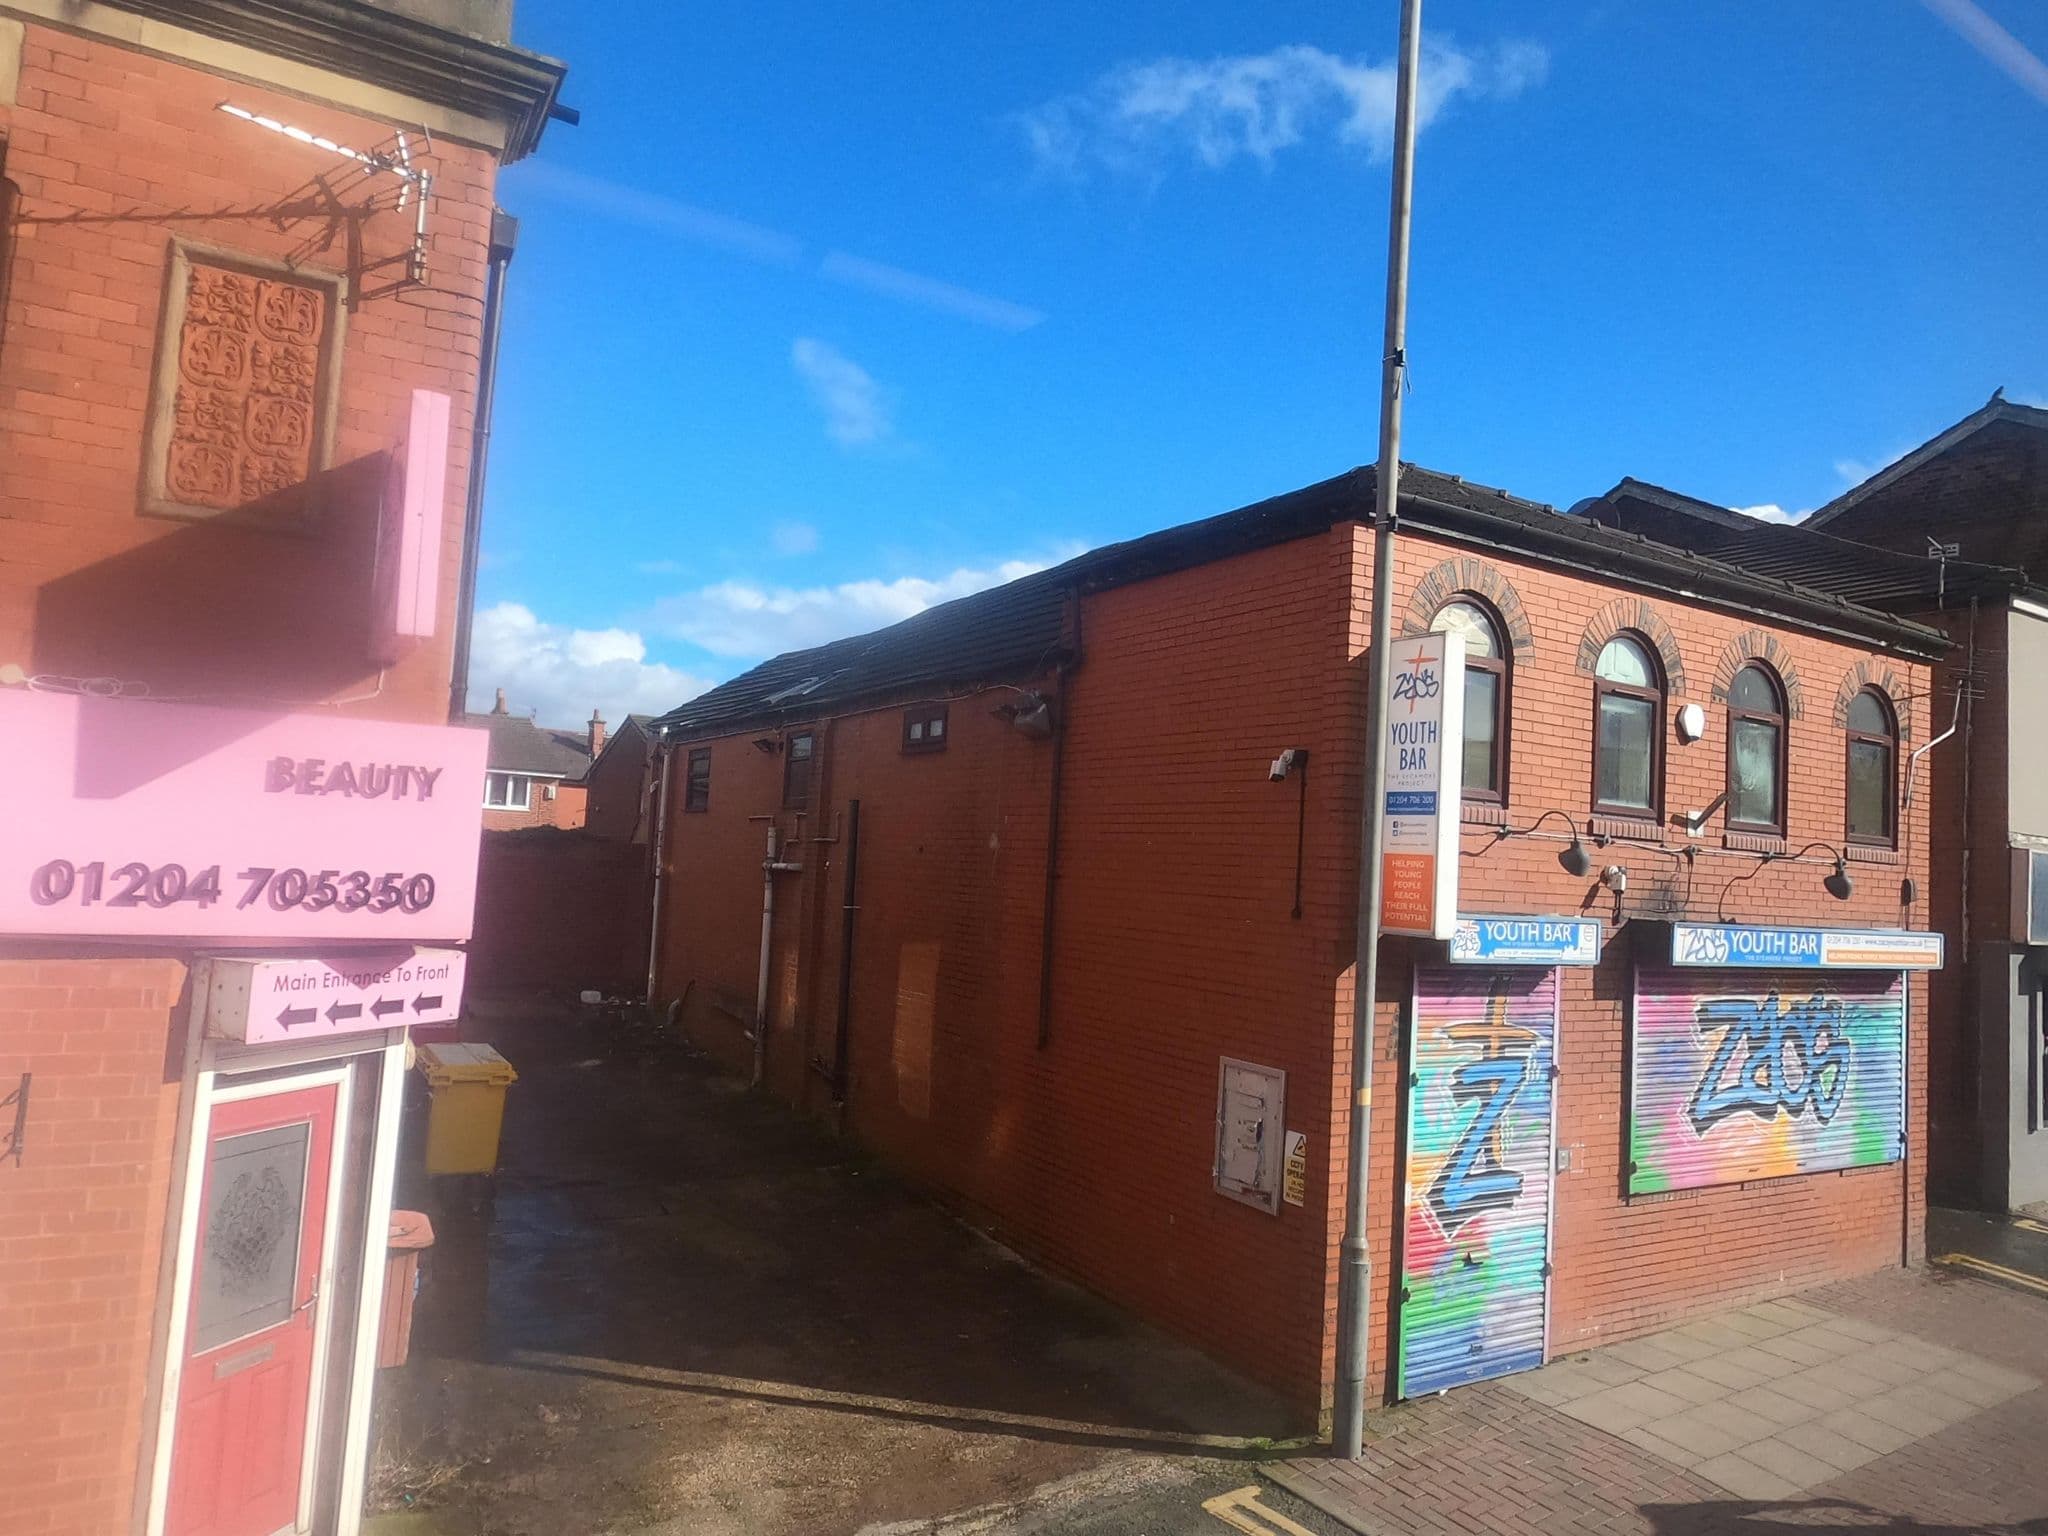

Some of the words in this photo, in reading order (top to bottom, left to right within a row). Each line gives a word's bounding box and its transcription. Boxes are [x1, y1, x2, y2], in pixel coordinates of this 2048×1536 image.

[1391, 720, 1437, 745] YOUTH
[1399, 747, 1427, 770] BAR
[267, 756, 443, 801] BEAUTY
[1392, 859, 1425, 868] HELPING
[1394, 870, 1422, 879] YOUNG
[36, 860, 221, 909] 01204
[237, 866, 436, 916] 705350
[1393, 880, 1421, 889] PEOPLE
[1385, 912, 1427, 922] POTENTIAL
[1386, 902, 1408, 910] THEIR
[1408, 903, 1428, 911] FULL
[1485, 921, 1540, 942] YOUTH
[1543, 923, 1573, 943] BAR
[1730, 931, 1787, 955] YOUTH
[1790, 935, 1819, 956] BAR
[273, 974, 316, 993] Main
[323, 969, 391, 989] Entrance
[397, 967, 412, 982] To
[416, 964, 449, 980] Front
